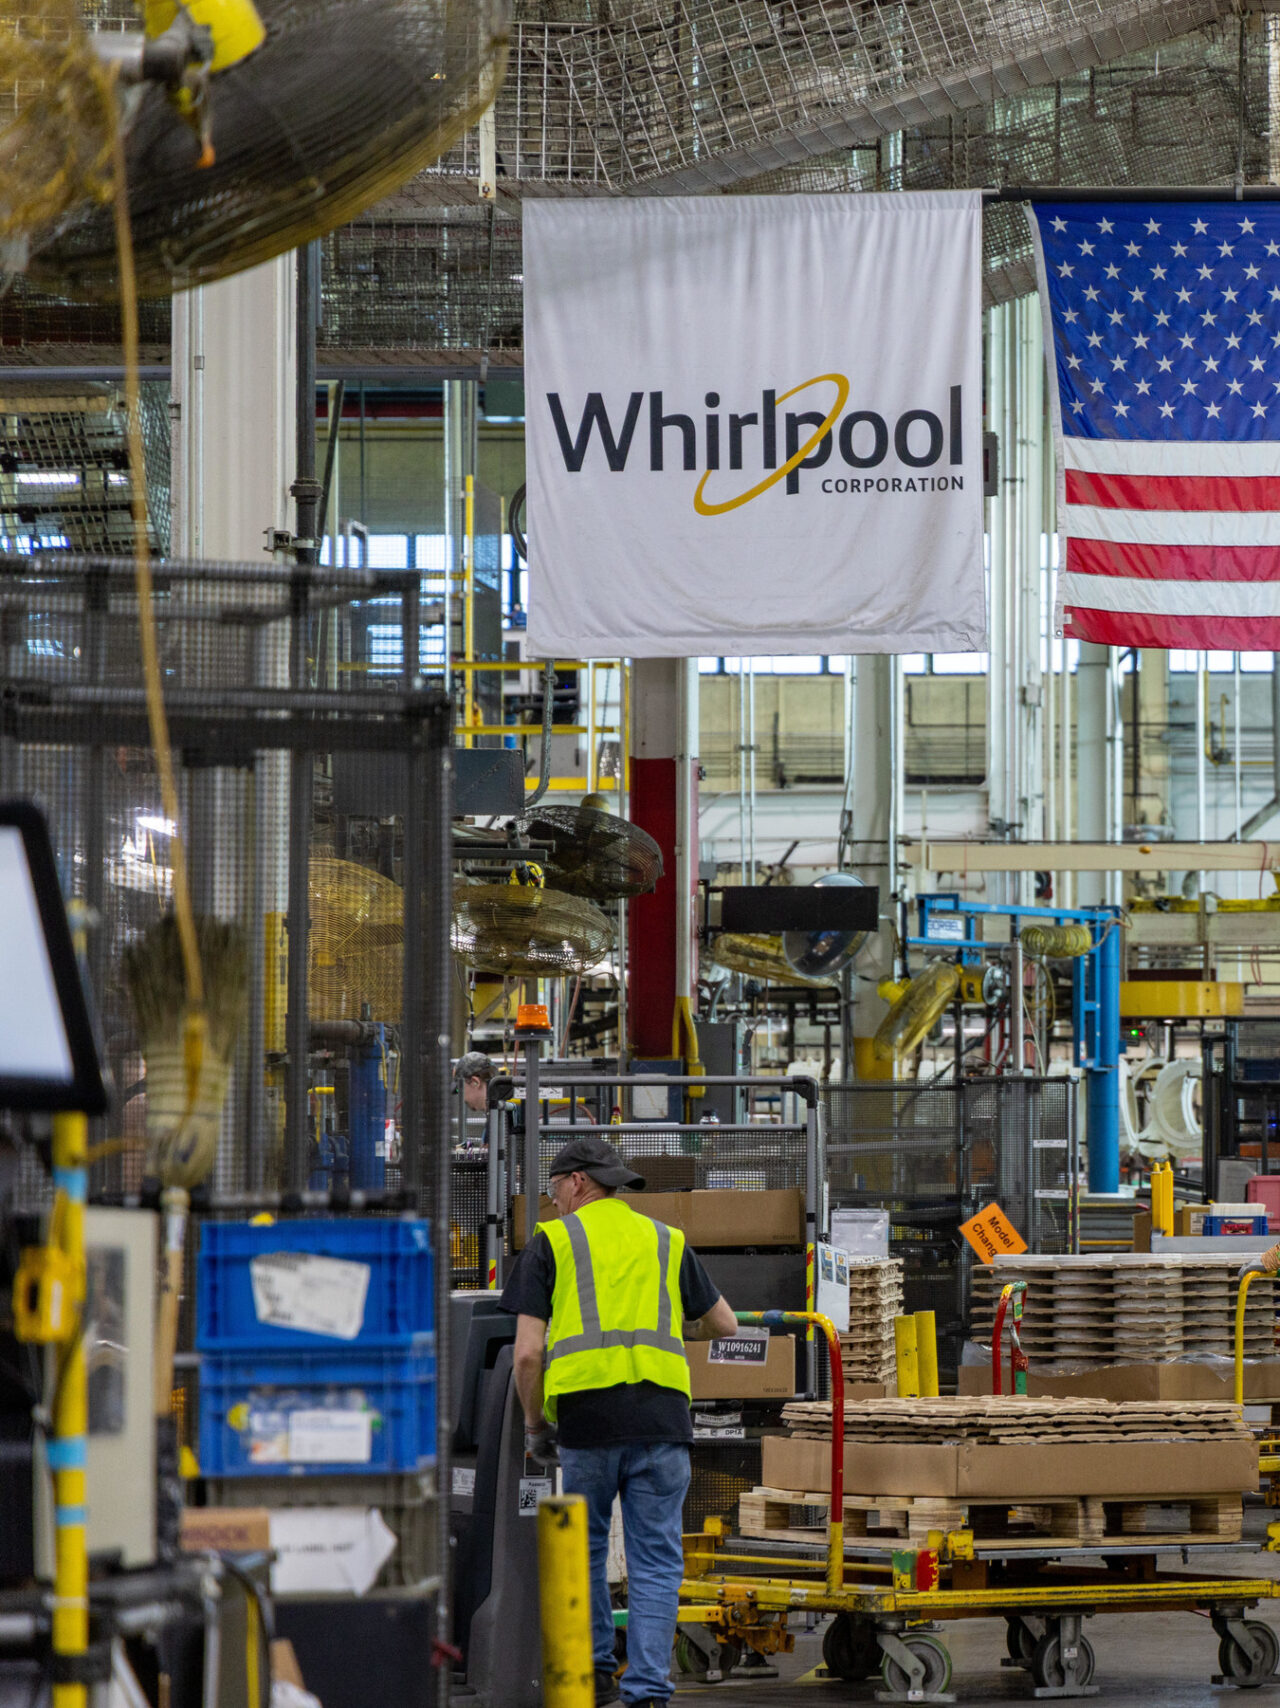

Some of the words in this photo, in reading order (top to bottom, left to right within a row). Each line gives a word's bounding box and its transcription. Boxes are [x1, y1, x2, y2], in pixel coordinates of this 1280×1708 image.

[546, 384, 963, 495] Whirlpool
[821, 476, 965, 493] CORPORATION
[972, 1223, 998, 1257] Chang
[988, 1216, 1015, 1248] Model
